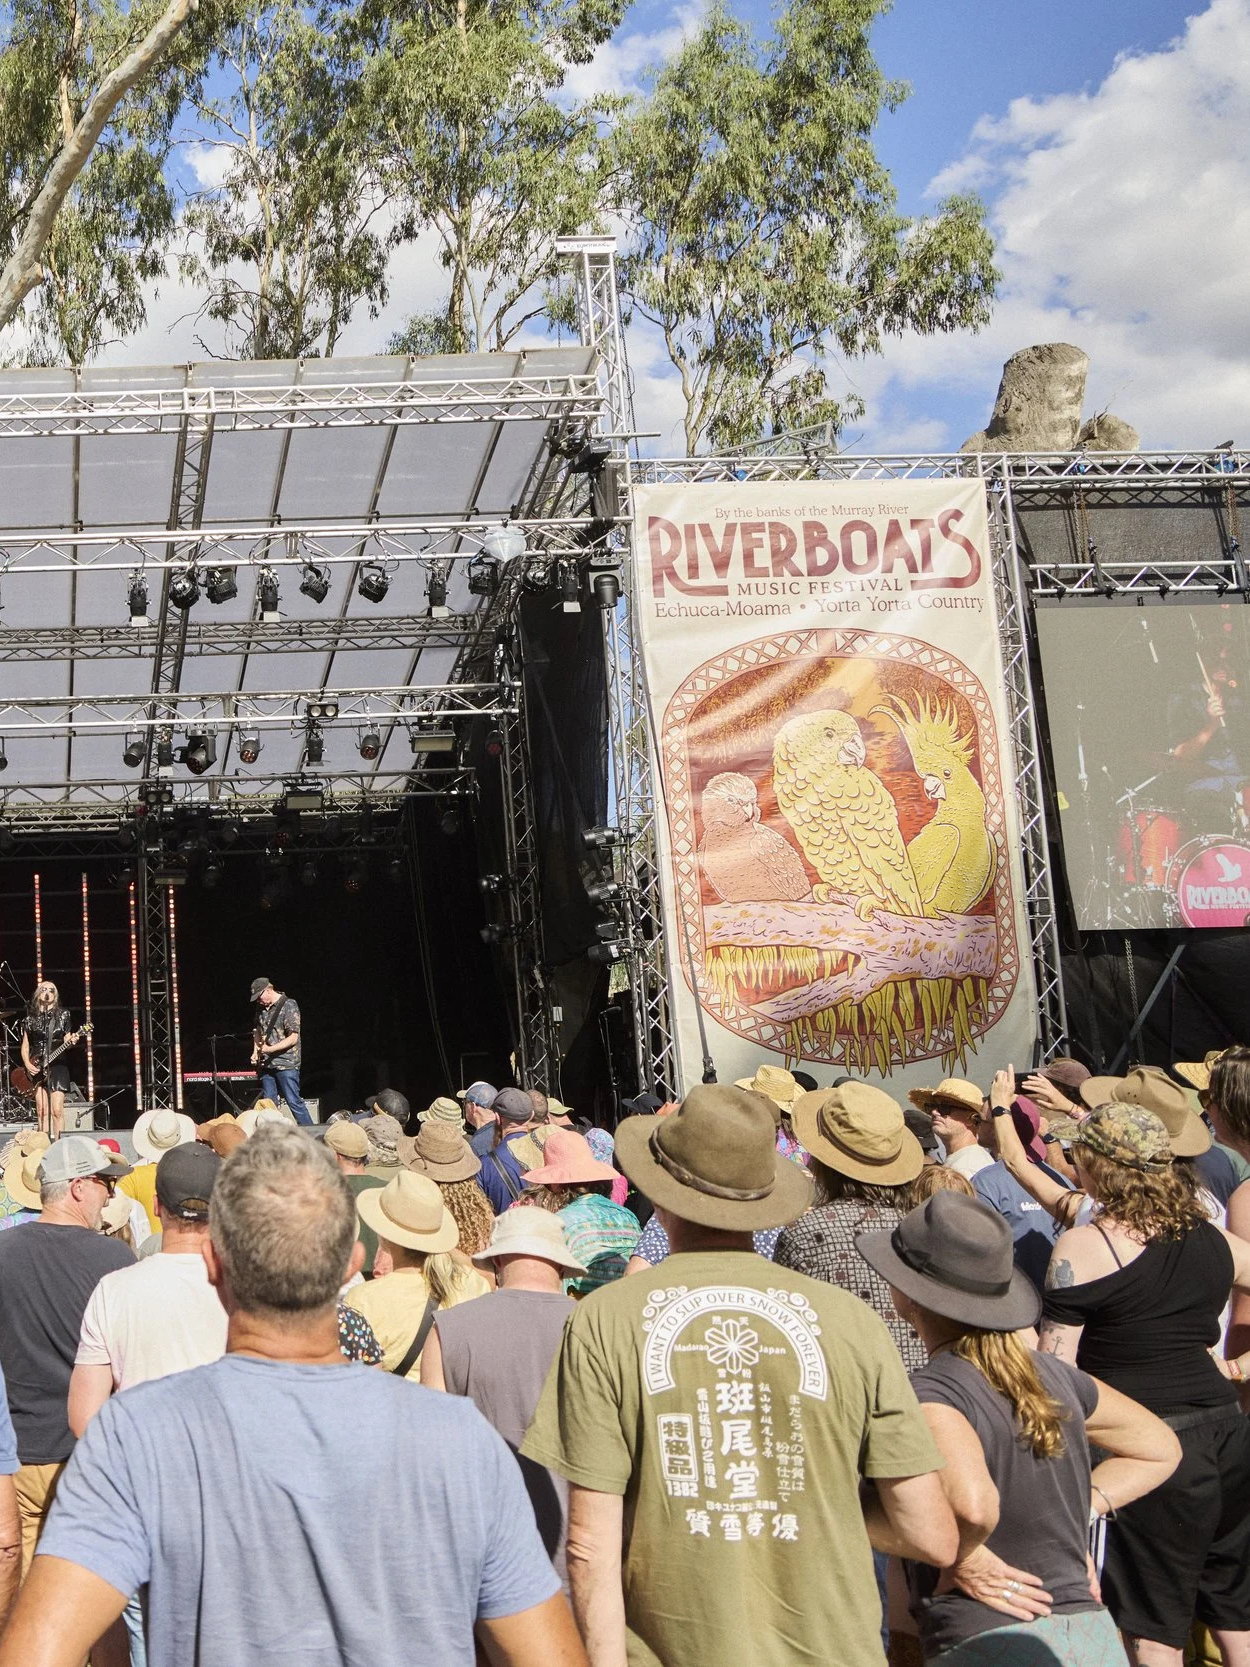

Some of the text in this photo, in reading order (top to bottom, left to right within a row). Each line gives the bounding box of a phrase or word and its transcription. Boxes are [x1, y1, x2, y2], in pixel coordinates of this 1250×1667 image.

[715, 504, 909, 519] By the banks of the Murray River
[648, 508, 982, 598] RIVERBOATS
[737, 578, 903, 596] MUSIC FESTIVAL
[655, 593, 985, 618] Echuca-Moama Yorta Yorta Country
[1186, 884, 1250, 910] RIVERBO
[650, 1333, 667, 1376] WANT
[660, 1315, 678, 1332] TO
[676, 1296, 702, 1318] SLIP
[706, 1292, 745, 1304] OVER
[750, 1296, 793, 1325] SNOW
[790, 1325, 821, 1388] FOREVER
[759, 1345, 786, 1355] Japan
[666, 1480, 699, 1498] 1382
